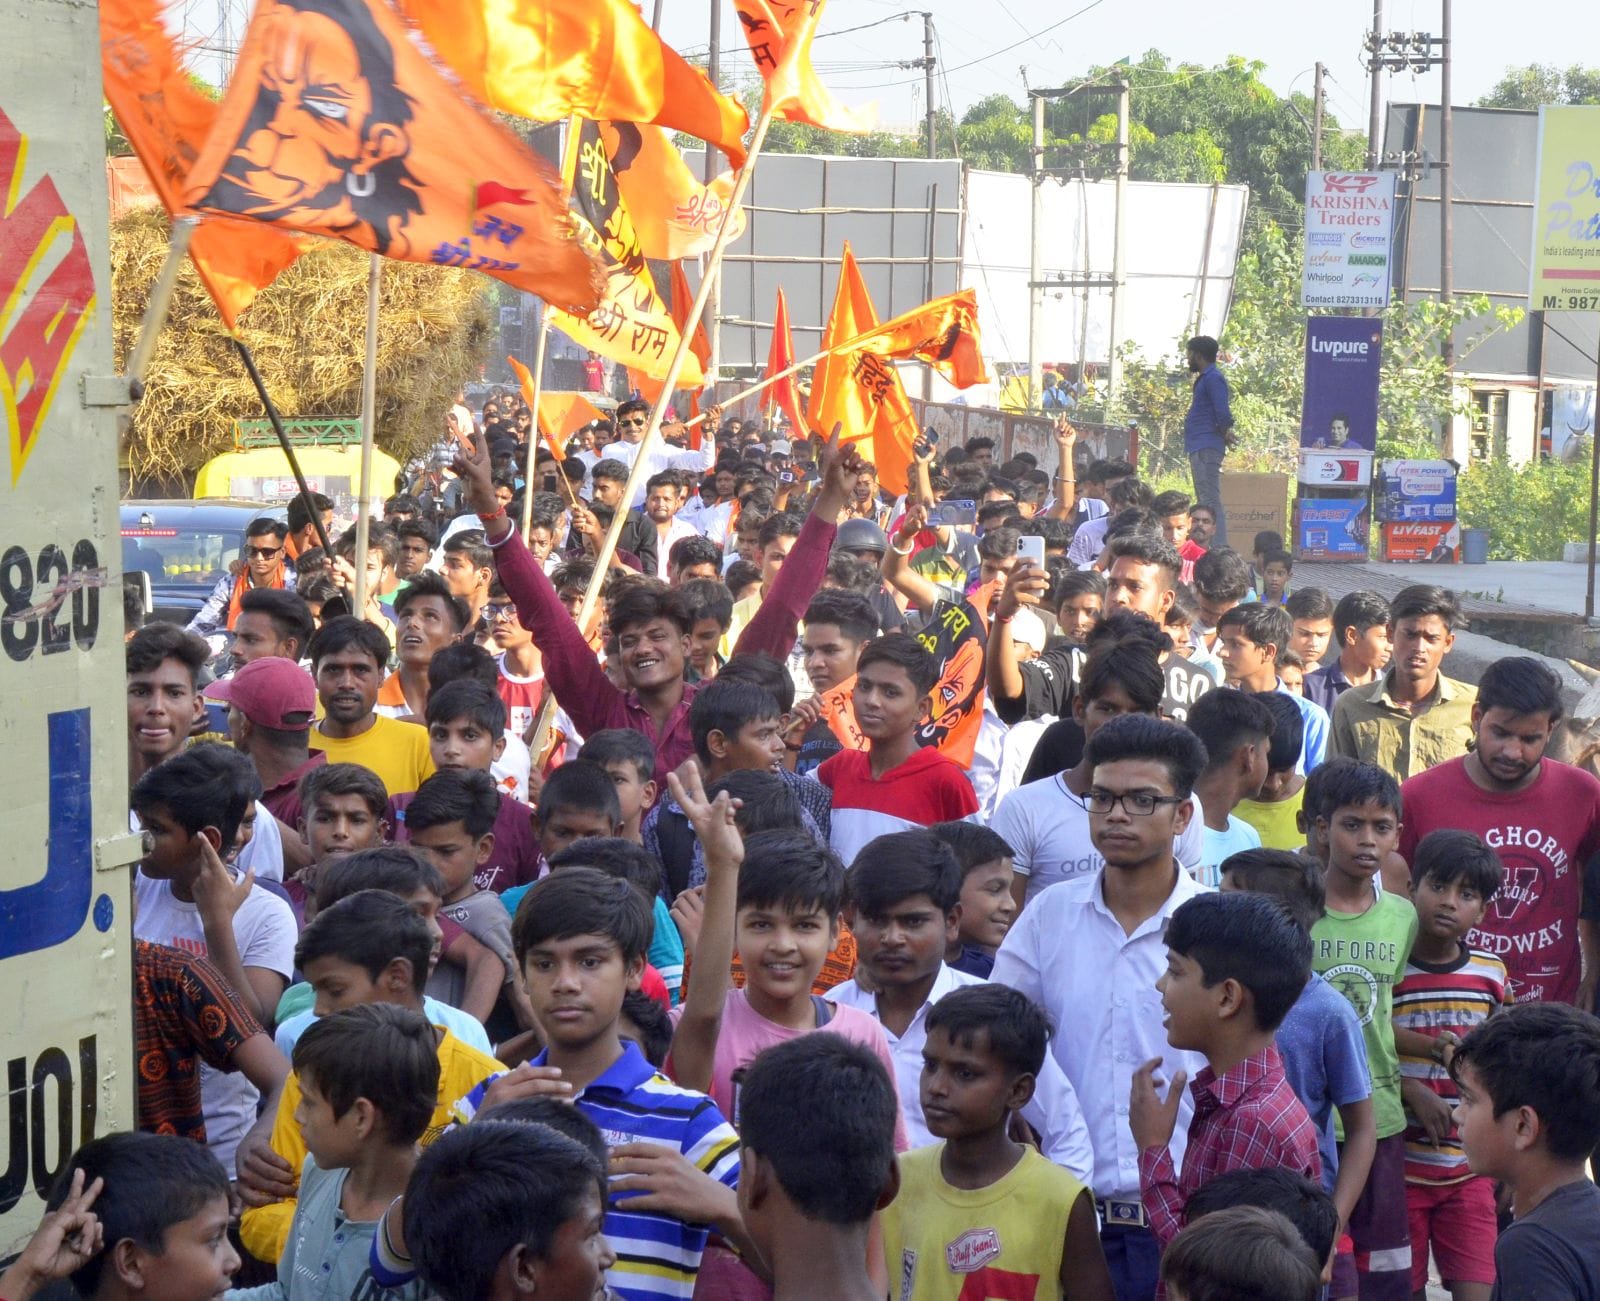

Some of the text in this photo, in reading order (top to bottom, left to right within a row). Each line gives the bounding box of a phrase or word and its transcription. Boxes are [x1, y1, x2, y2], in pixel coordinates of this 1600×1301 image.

[1309, 195, 1390, 211] KRISHNA
[1317, 210, 1382, 227] Traders
[1307, 272, 1344, 284] Whirlpool
[1305, 294, 1335, 304] Contact
[1543, 295, 1562, 309] M:
[630, 320, 669, 360] राम
[1311, 335, 1369, 357] Livpure
[1392, 522, 1442, 536] LIVFAST
[941, 606, 971, 642] जय
